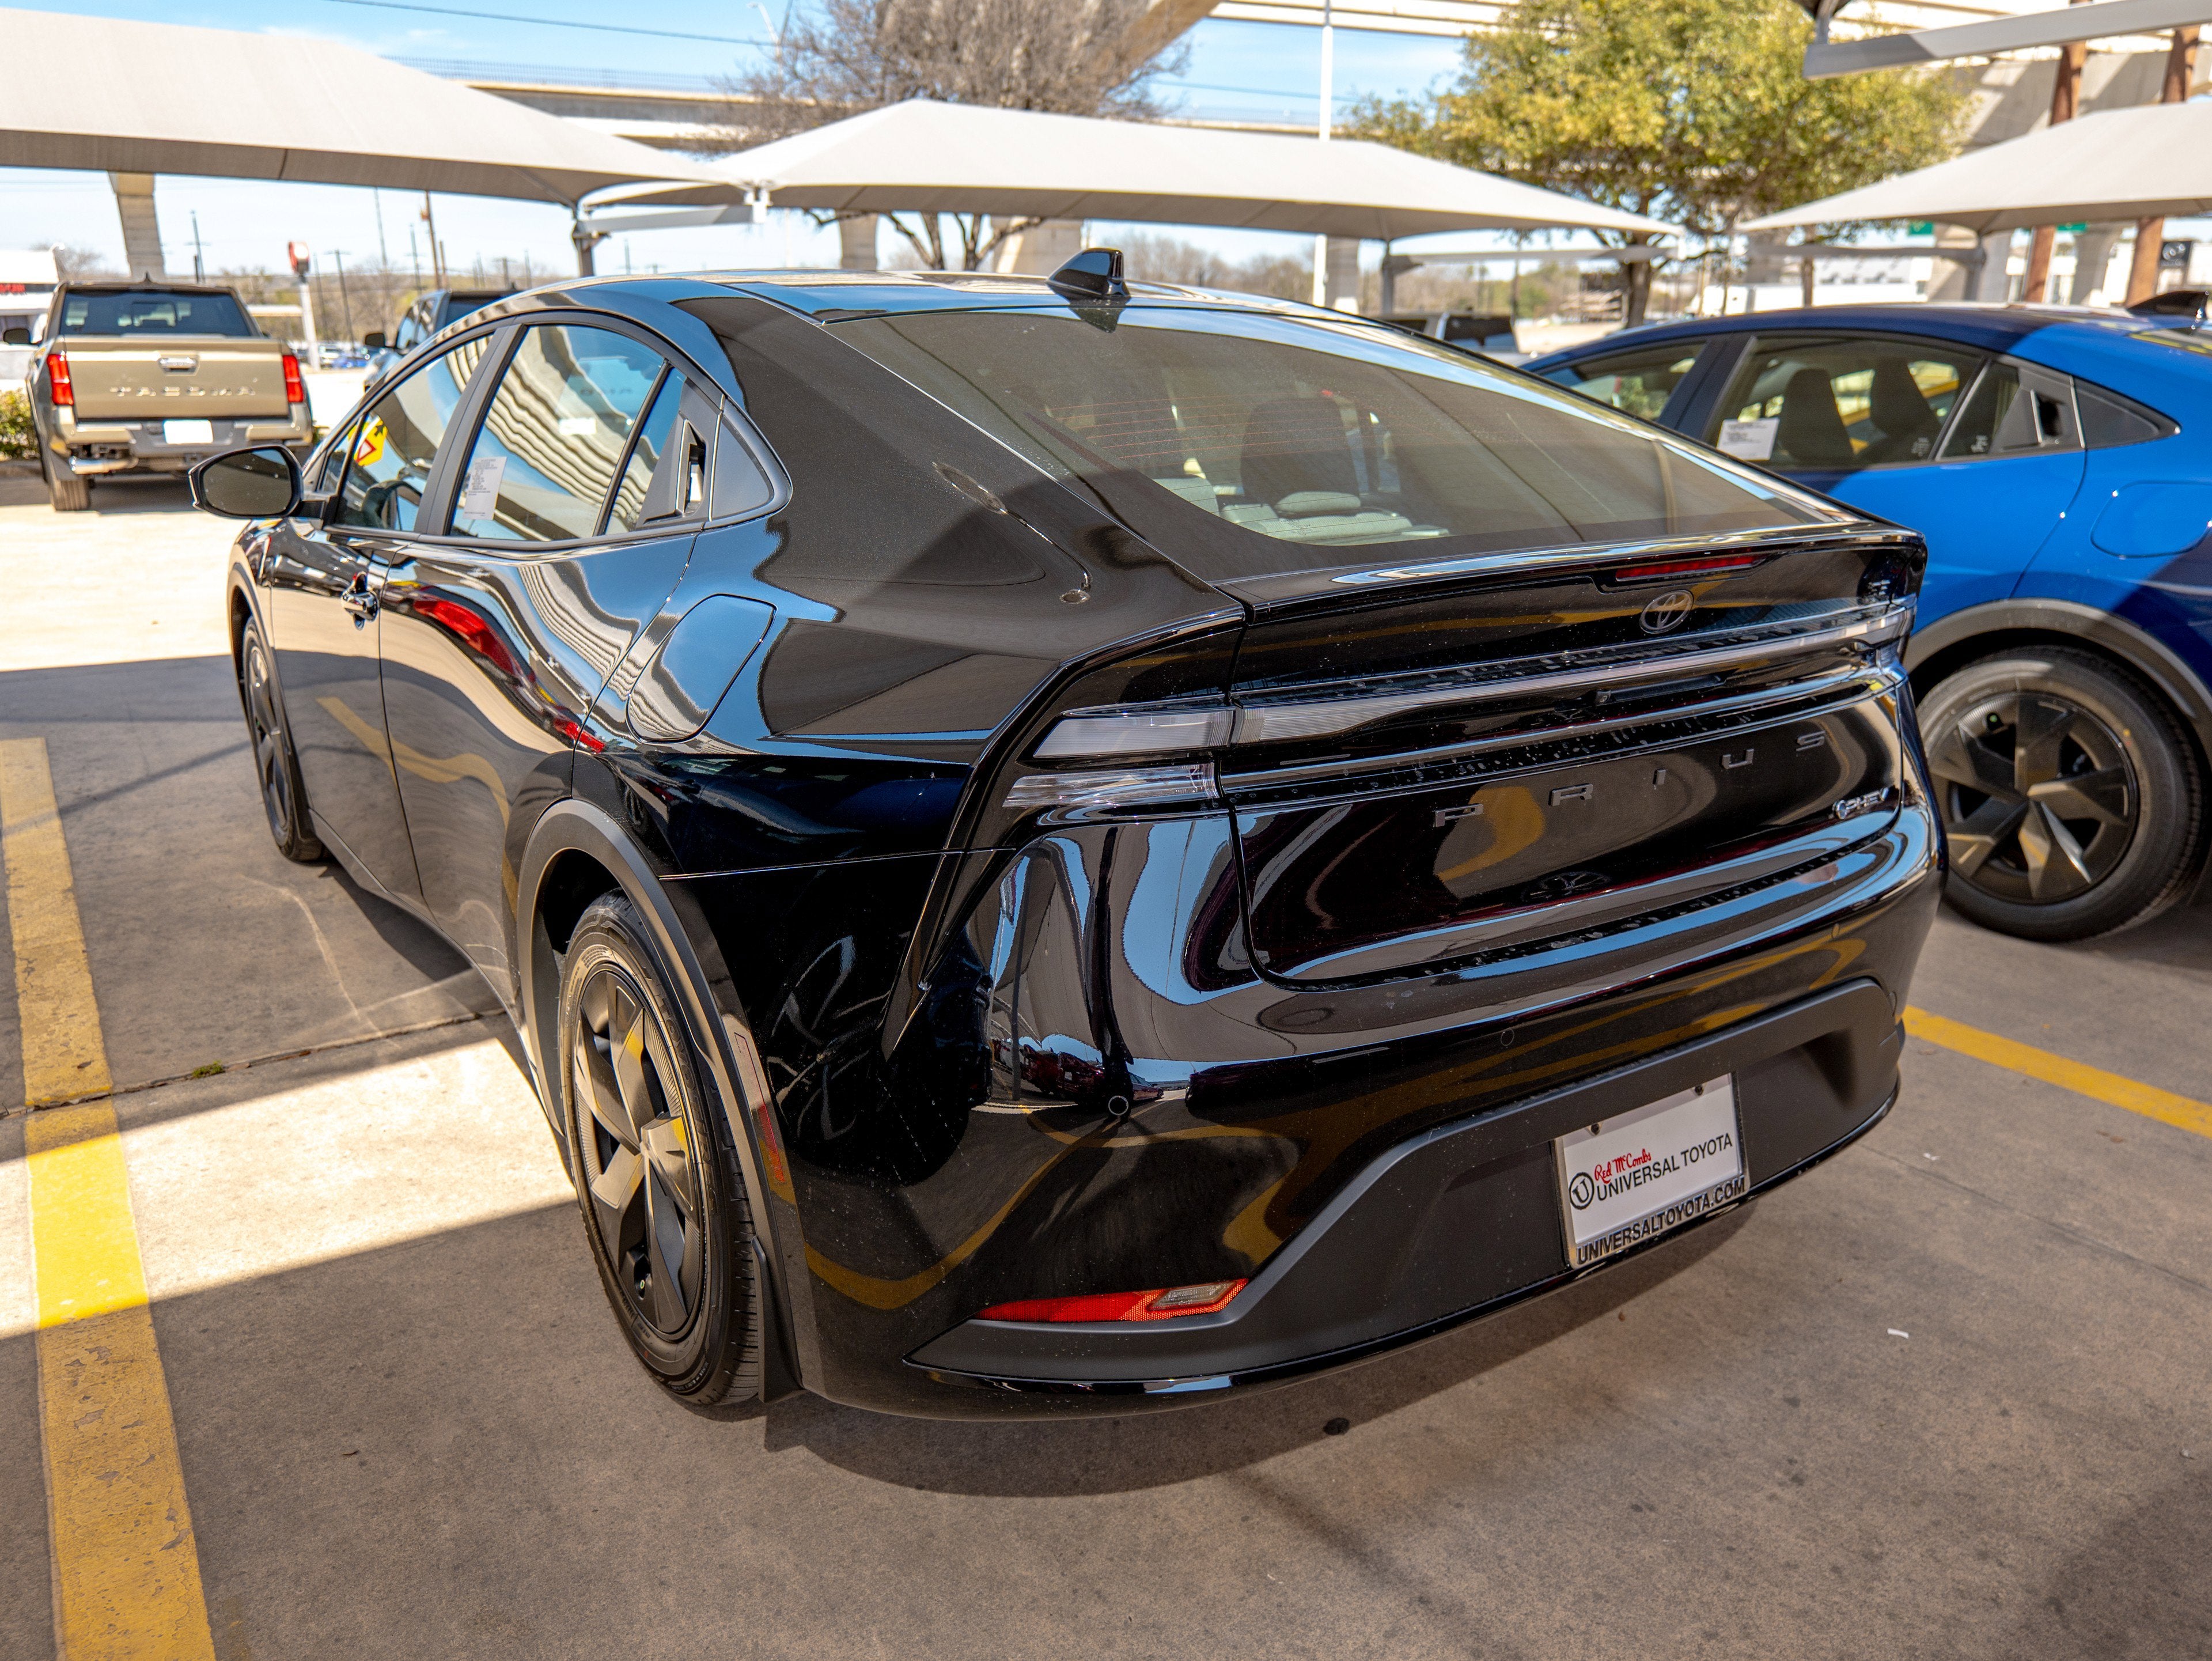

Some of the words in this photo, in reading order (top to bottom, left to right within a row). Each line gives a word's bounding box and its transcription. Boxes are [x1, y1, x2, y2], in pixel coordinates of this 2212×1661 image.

[1433, 731, 1826, 828] PRIUS
[1594, 1161, 1612, 1184] Red
[1613, 1148, 1652, 1174] McCombs
[1596, 1155, 1680, 1201] UNIVERSAL
[1680, 1132, 1733, 1167] TOYOTA
[1576, 1174, 1745, 1265] UNIVERSALTOYOTA.COM
